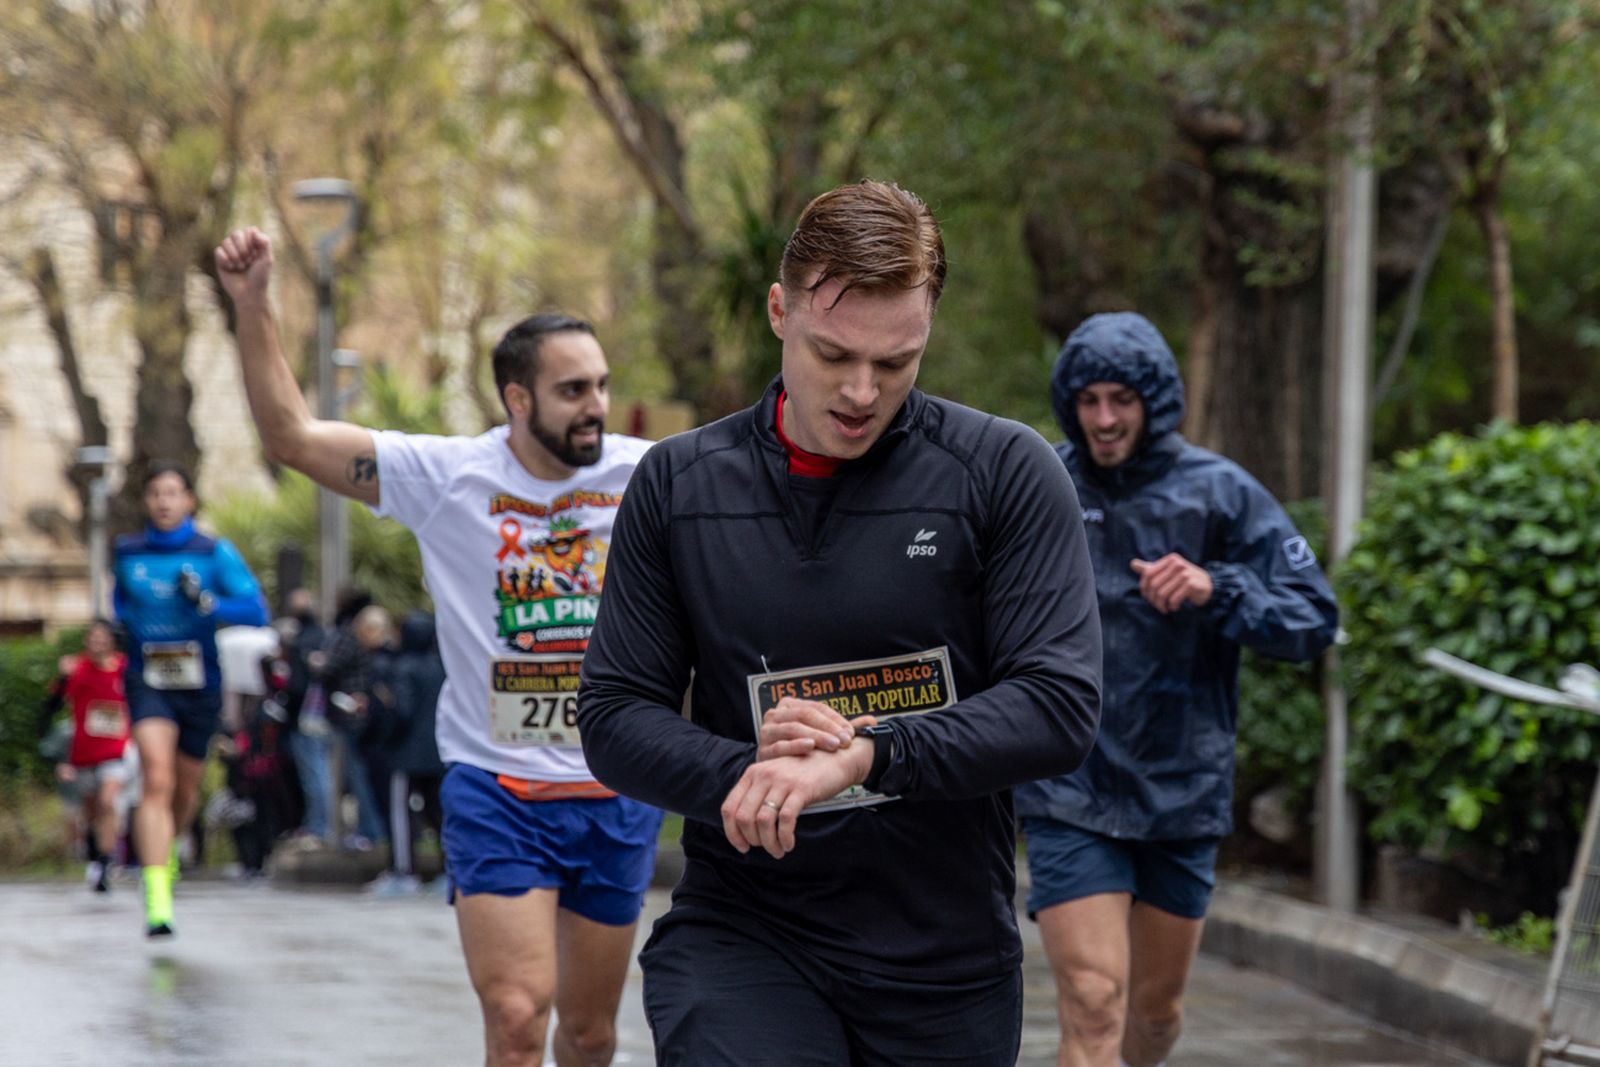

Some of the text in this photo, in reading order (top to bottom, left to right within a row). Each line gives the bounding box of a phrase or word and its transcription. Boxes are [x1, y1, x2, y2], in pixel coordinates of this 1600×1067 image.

[514, 603, 550, 627] LA
[770, 664, 932, 702] IES San Juan Bosco
[866, 683, 942, 713] POPULAR
[521, 697, 577, 729] 276
